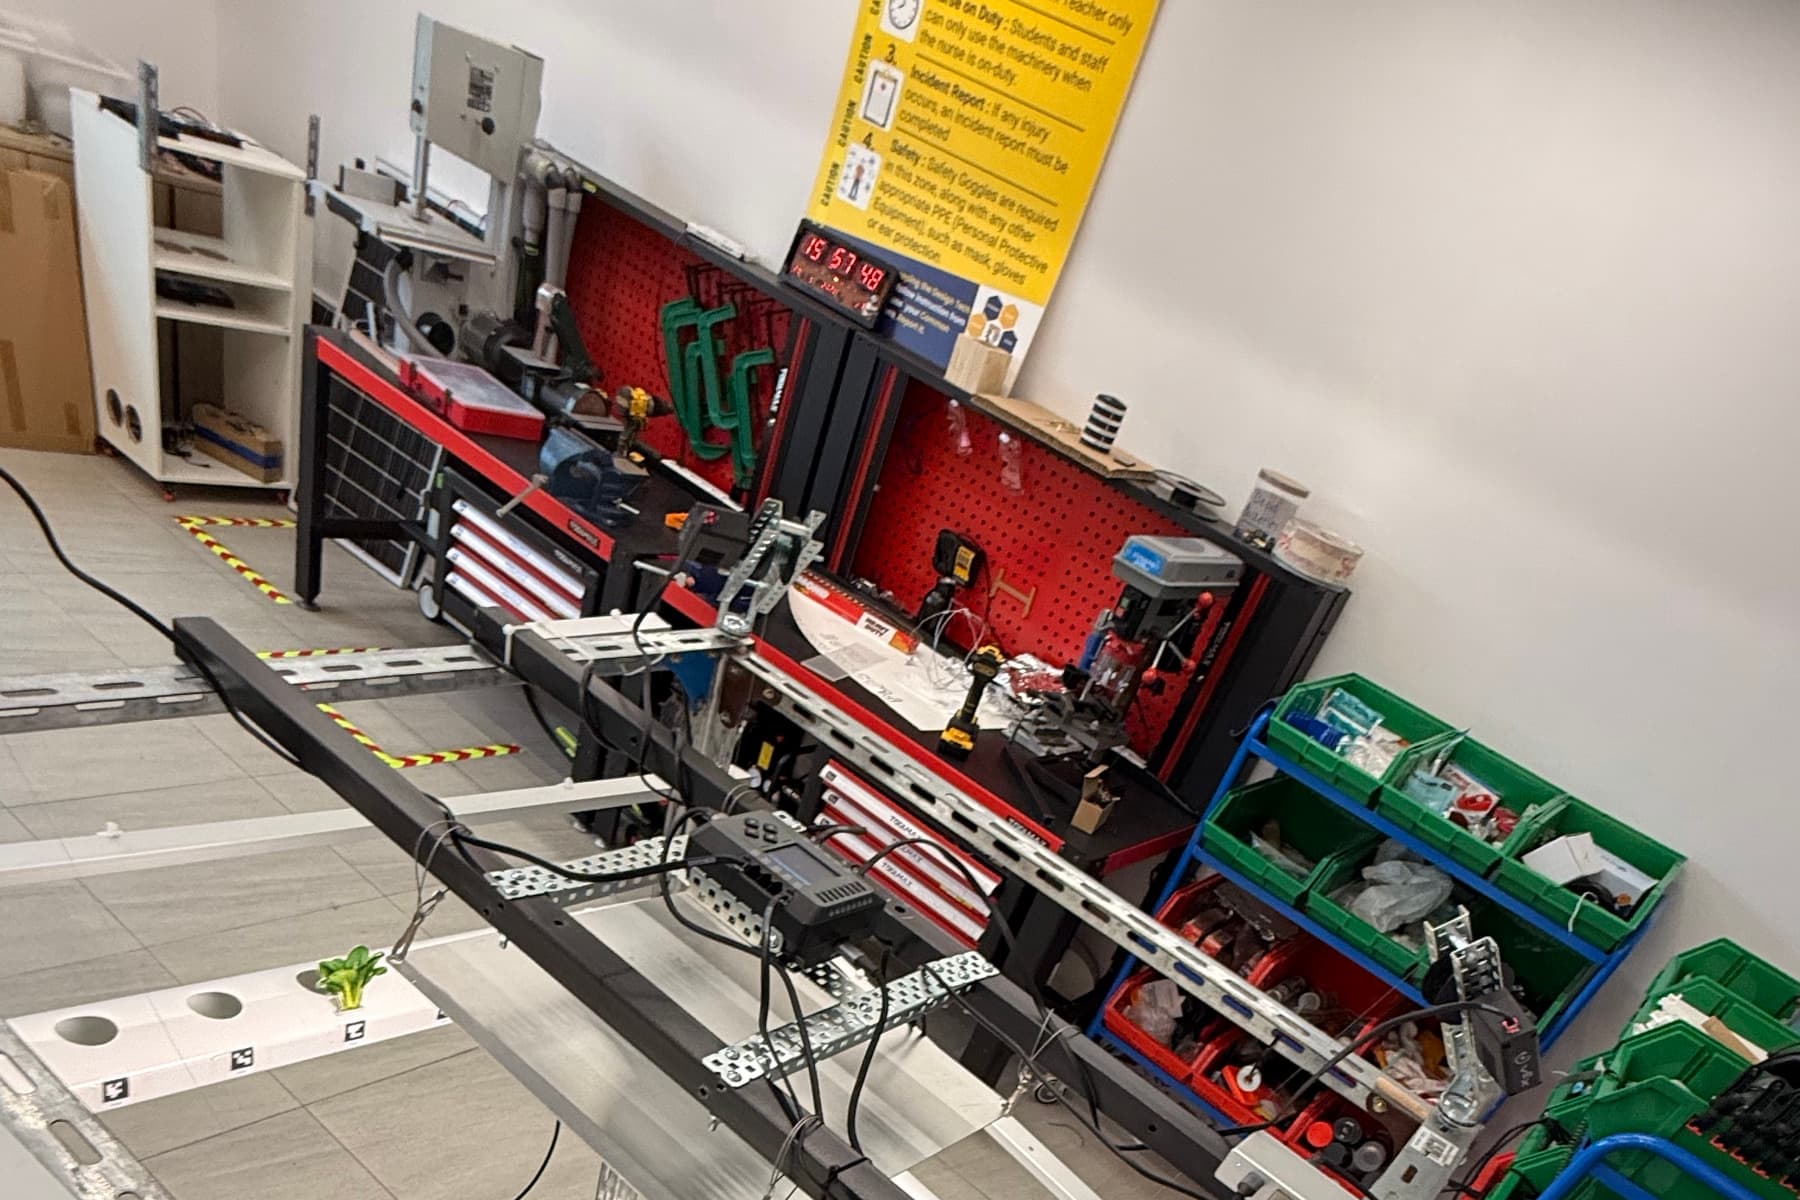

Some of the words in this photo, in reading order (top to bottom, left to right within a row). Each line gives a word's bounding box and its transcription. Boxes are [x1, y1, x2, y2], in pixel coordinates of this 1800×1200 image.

[919, 28, 937, 49] the
[936, 39, 966, 62] nurse
[924, 9, 944, 27] can
[944, 18, 968, 41] only
[967, 30, 988, 47] use
[988, 35, 1006, 55] the
[1006, 45, 1062, 83] machinery
[1061, 70, 1092, 93] when
[962, 1, 978, 16] on
[977, 4, 1004, 31] Duty
[1008, 18, 1058, 52] Students
[1056, 42, 1081, 62] and
[1079, 52, 1110, 74] staff
[1107, 12, 1134, 37] only
[854, 33, 874, 85] CAUTION
[884, 42, 898, 66] 3.
[839, 100, 857, 148] CAUTION
[898, 108, 951, 142] completed
[909, 64, 951, 95] Incident
[950, 83, 986, 112] Report
[1000, 110, 1021, 131] any
[1019, 115, 1052, 145] injury
[939, 105, 954, 121] an
[954, 110, 995, 140] incident
[993, 130, 1027, 155] report
[1026, 146, 1055, 168] must
[1052, 156, 1069, 175] be
[821, 162, 840, 207] CAUTION
[889, 138, 922, 167] Safety
[926, 156, 958, 185] Safety
[957, 171, 999, 203] Goggles
[998, 194, 1016, 212] are
[1015, 203, 1060, 233] required
[894, 164, 913, 184] this
[938, 187, 968, 214] along
[966, 203, 988, 220] with
[988, 213, 1008, 233] any
[1007, 222, 1036, 243] other
[877, 180, 932, 215] appropriate
[930, 203, 954, 226] PPE
[998, 238, 1049, 274] Protective
[877, 223, 896, 238] ear
[805, 237, 827, 262] 15
[828, 247, 857, 276] 57
[861, 263, 886, 291] 48
[926, 226, 951, 247] such
[950, 239, 964, 254] as
[991, 261, 1027, 286] gloves
